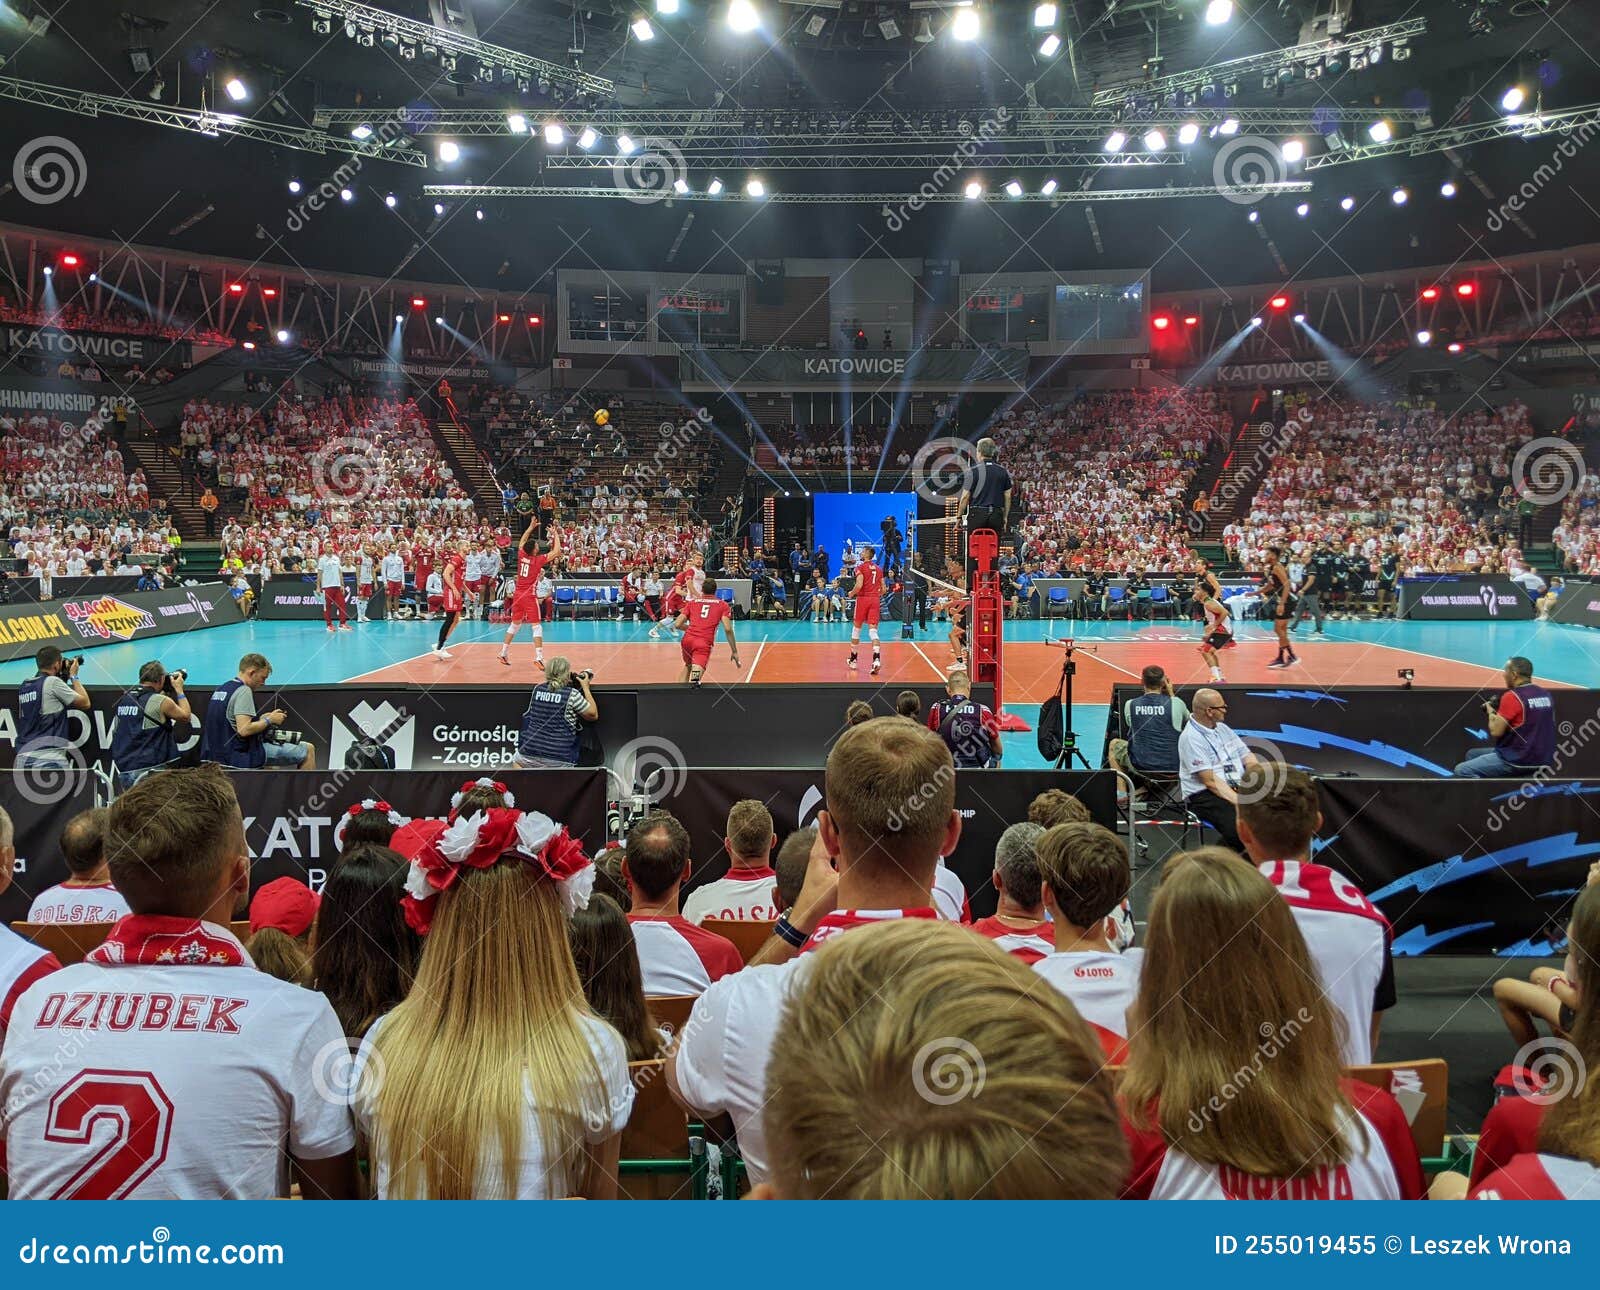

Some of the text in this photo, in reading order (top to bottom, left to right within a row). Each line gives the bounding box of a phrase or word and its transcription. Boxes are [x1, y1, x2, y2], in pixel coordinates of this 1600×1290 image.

[8, 329, 143, 359] KATOWICE
[804, 358, 905, 374] KATOWICE
[1216, 361, 1329, 382] KATOWICE
[0, 390, 96, 412] HAMPIONSHIP
[520, 563, 530, 578] 19
[872, 571, 877, 584] 7
[275, 595, 301, 605] POLAND
[1422, 595, 1517, 605] POLAND SLOVENIA 2022
[64, 600, 121, 619] BLACHY
[700, 605, 709, 618] 5
[75, 613, 156, 638] PRUSZYŃSKI
[535, 691, 561, 704] PHOTO
[118, 706, 138, 717] PHOTO
[1135, 705, 1165, 716] PHOTO
[432, 725, 519, 746] Górnoślą
[34, 905, 119, 923] POLSKA
[1087, 968, 1113, 977] LOTOS
[35, 992, 248, 1034] DZIUBEK
[44, 1068, 174, 1200] 2
